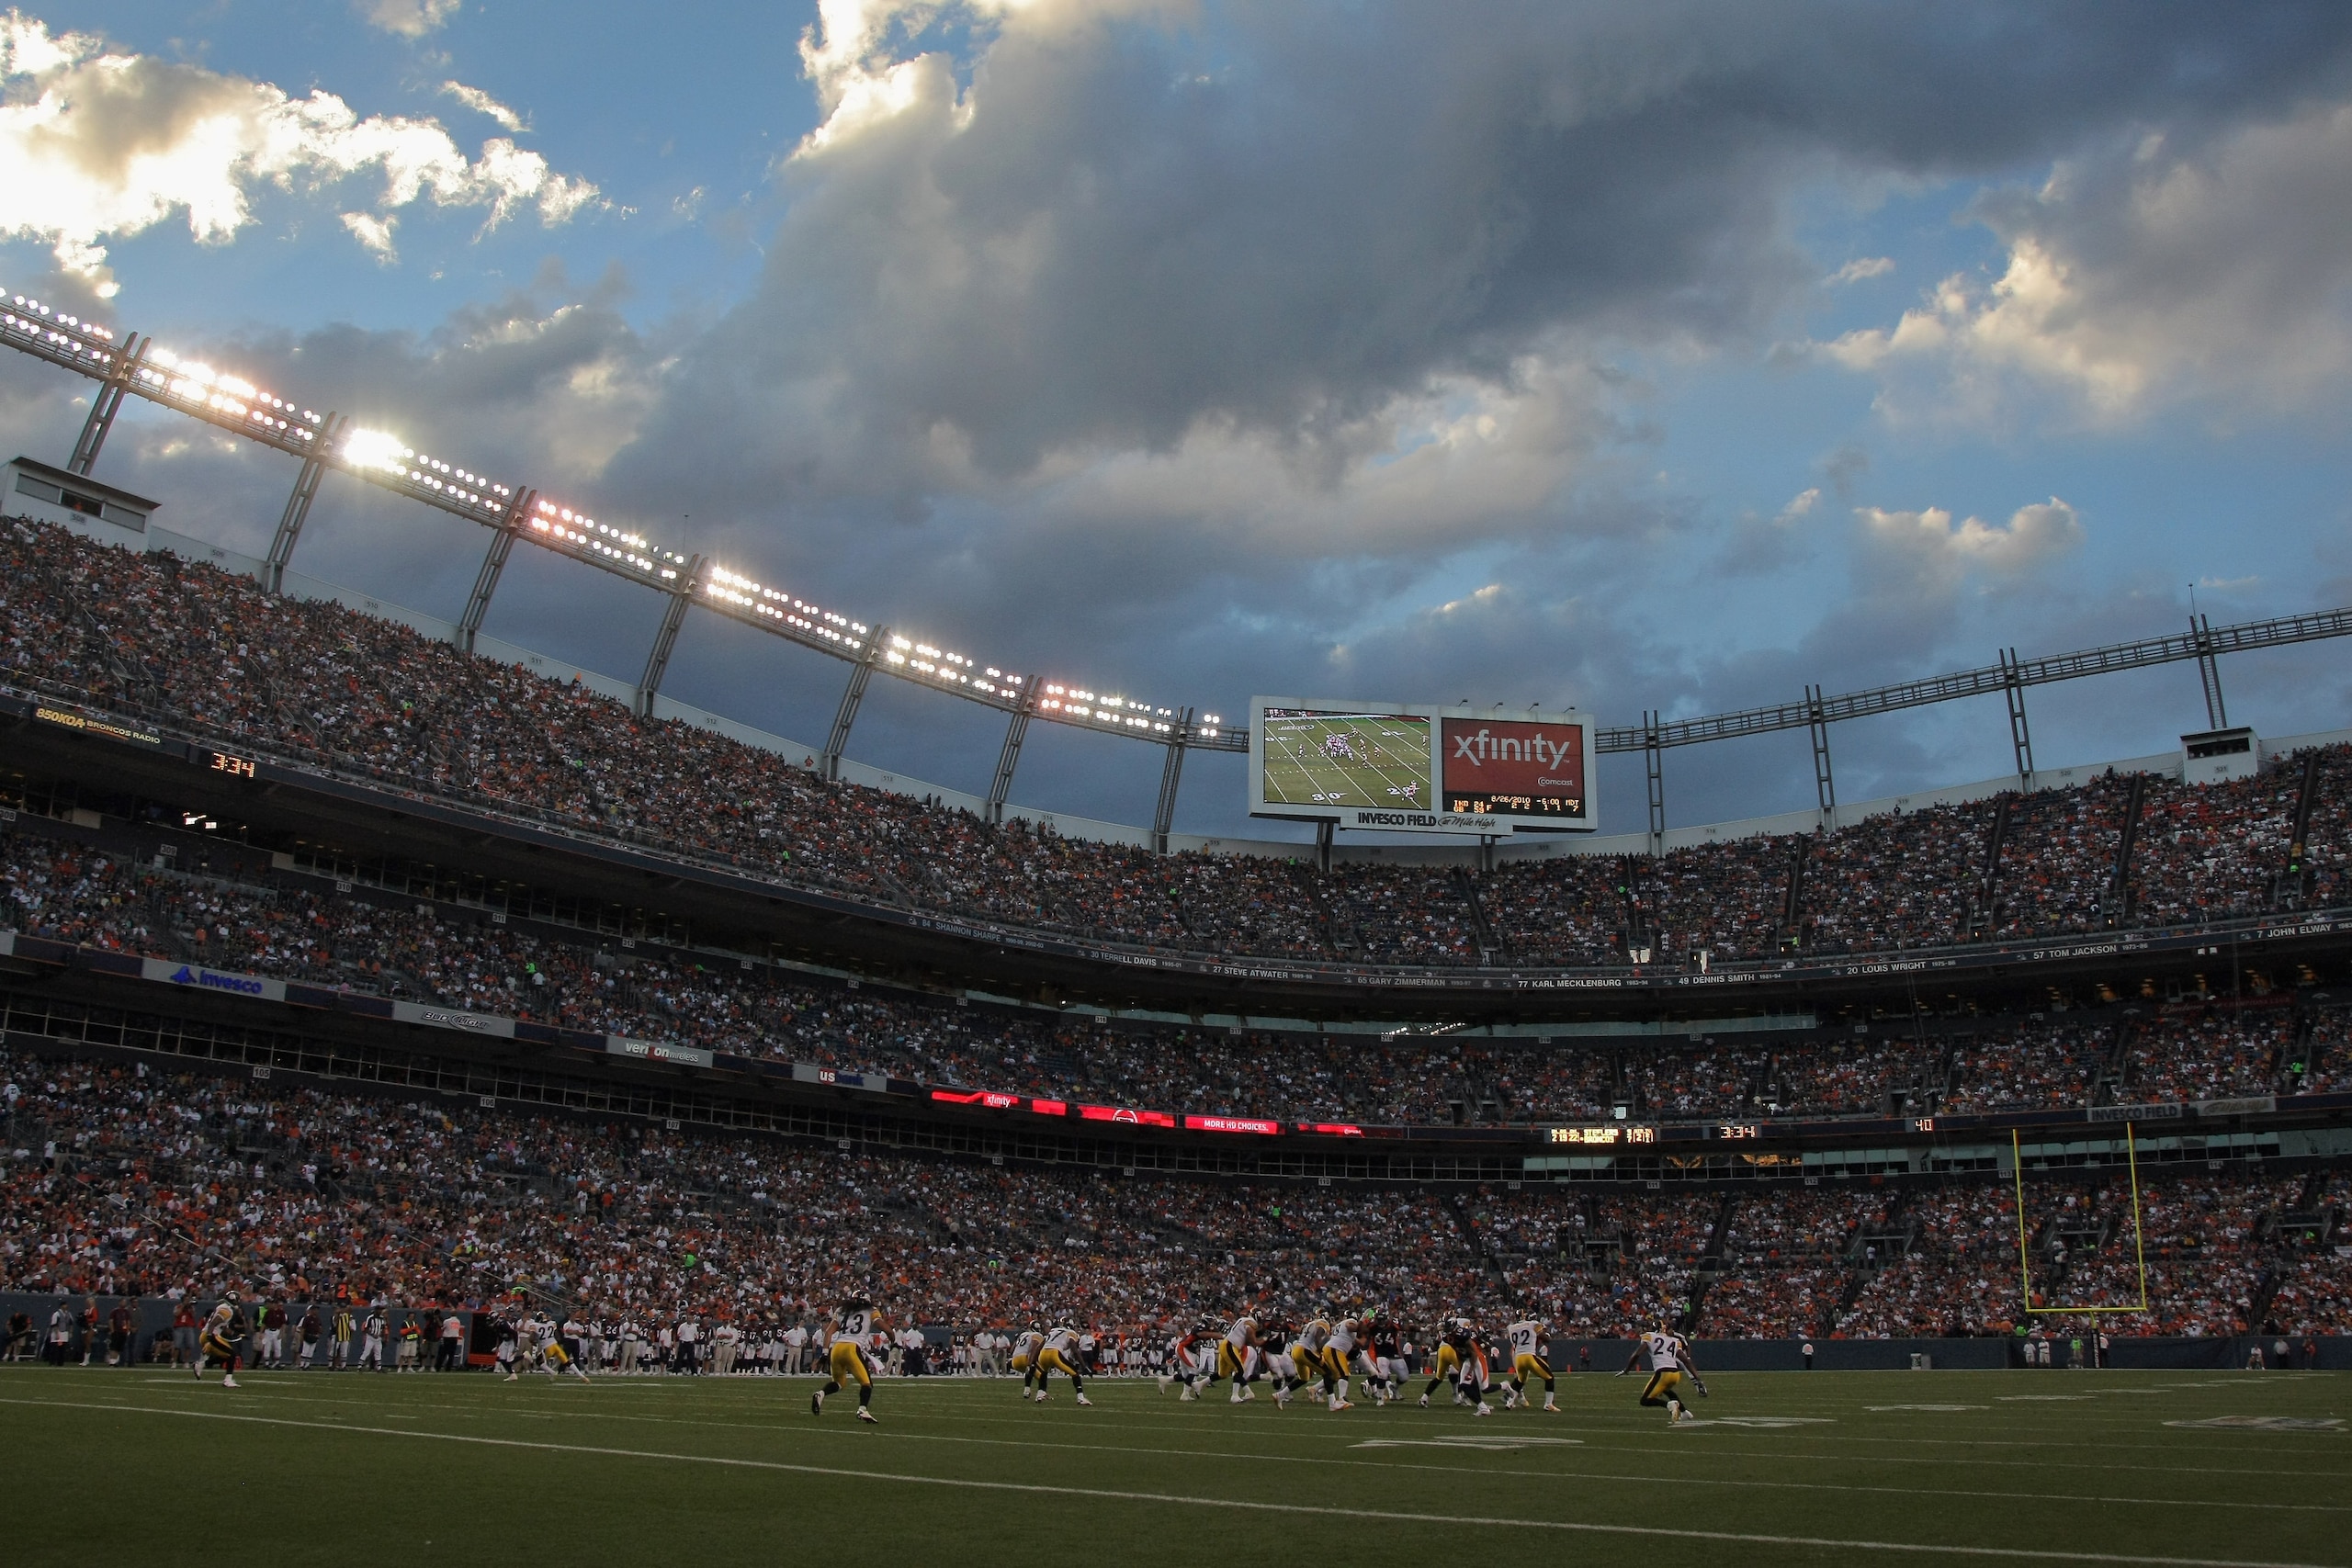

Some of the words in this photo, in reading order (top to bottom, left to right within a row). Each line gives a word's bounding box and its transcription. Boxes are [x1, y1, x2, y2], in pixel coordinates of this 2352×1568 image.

[86, 719, 131, 737] BRONCOS
[132, 731, 161, 744] RADIO
[1453, 728, 1570, 771] xfinity
[211, 752, 255, 778] 3:34
[1490, 795, 1531, 804] 8/26/2010
[1358, 812, 1405, 826] INVESCO
[1408, 815, 1437, 827] FIELD
[1449, 817, 1474, 828] Mile
[1475, 818, 1496, 829] High
[922, 919, 931, 928] 84
[935, 921, 972, 937] SHANNON
[973, 930, 1001, 942] SHARPE
[2256, 931, 2263, 939] 7
[2267, 928, 2296, 938] JOHN
[2299, 923, 2332, 934] ELWAY
[1091, 950, 1100, 959] 30
[1101, 952, 1133, 964] TERRELL
[1134, 955, 1157, 966] DAVIS
[2033, 951, 2045, 960] 57
[2048, 948, 2070, 958] TOM
[2071, 944, 2118, 957] JACKSON
[1213, 965, 1222, 974] 27
[1224, 965, 1248, 976] STEVE
[1250, 968, 1289, 979] ATWATER
[1847, 966, 1858, 975] 20
[1861, 964, 1889, 974] LOUIS
[1891, 961, 1927, 971] WRIGHT
[1358, 976, 1368, 985] 65
[1369, 976, 1392, 986] GARY
[1394, 977, 1446, 987] ZIMMERMAN
[1518, 980, 1528, 988] 77
[1532, 979, 1555, 988] KARL
[1556, 979, 1622, 987] MECKLENBURG
[1679, 976, 1690, 985] 49
[1692, 975, 1725, 985] DENNIS
[1727, 973, 1755, 983] SMITH
[423, 1011, 449, 1022] BUD
[458, 1016, 490, 1029] LIGHT
[626, 1042, 669, 1060] verizon
[669, 1051, 699, 1063] wireless
[836, 1073, 865, 1087] bank
[987, 1096, 1011, 1108] xfinity
[2091, 1107, 2143, 1122] INVESCO
[2145, 1105, 2177, 1118] FIELD
[1204, 1119, 1225, 1129] MORE
[1226, 1121, 1237, 1129] HD
[1238, 1122, 1269, 1132] CHOICES.
[1721, 1126, 1756, 1139] 3:34
[1916, 1119, 1933, 1131] 40
[606, 1325, 618, 1335] 26
[841, 1310, 867, 1335] 43
[539, 1327, 555, 1340] 22
[1374, 1332, 1395, 1346] 64
[1511, 1329, 1530, 1347] 92
[1654, 1337, 1676, 1359] 24
